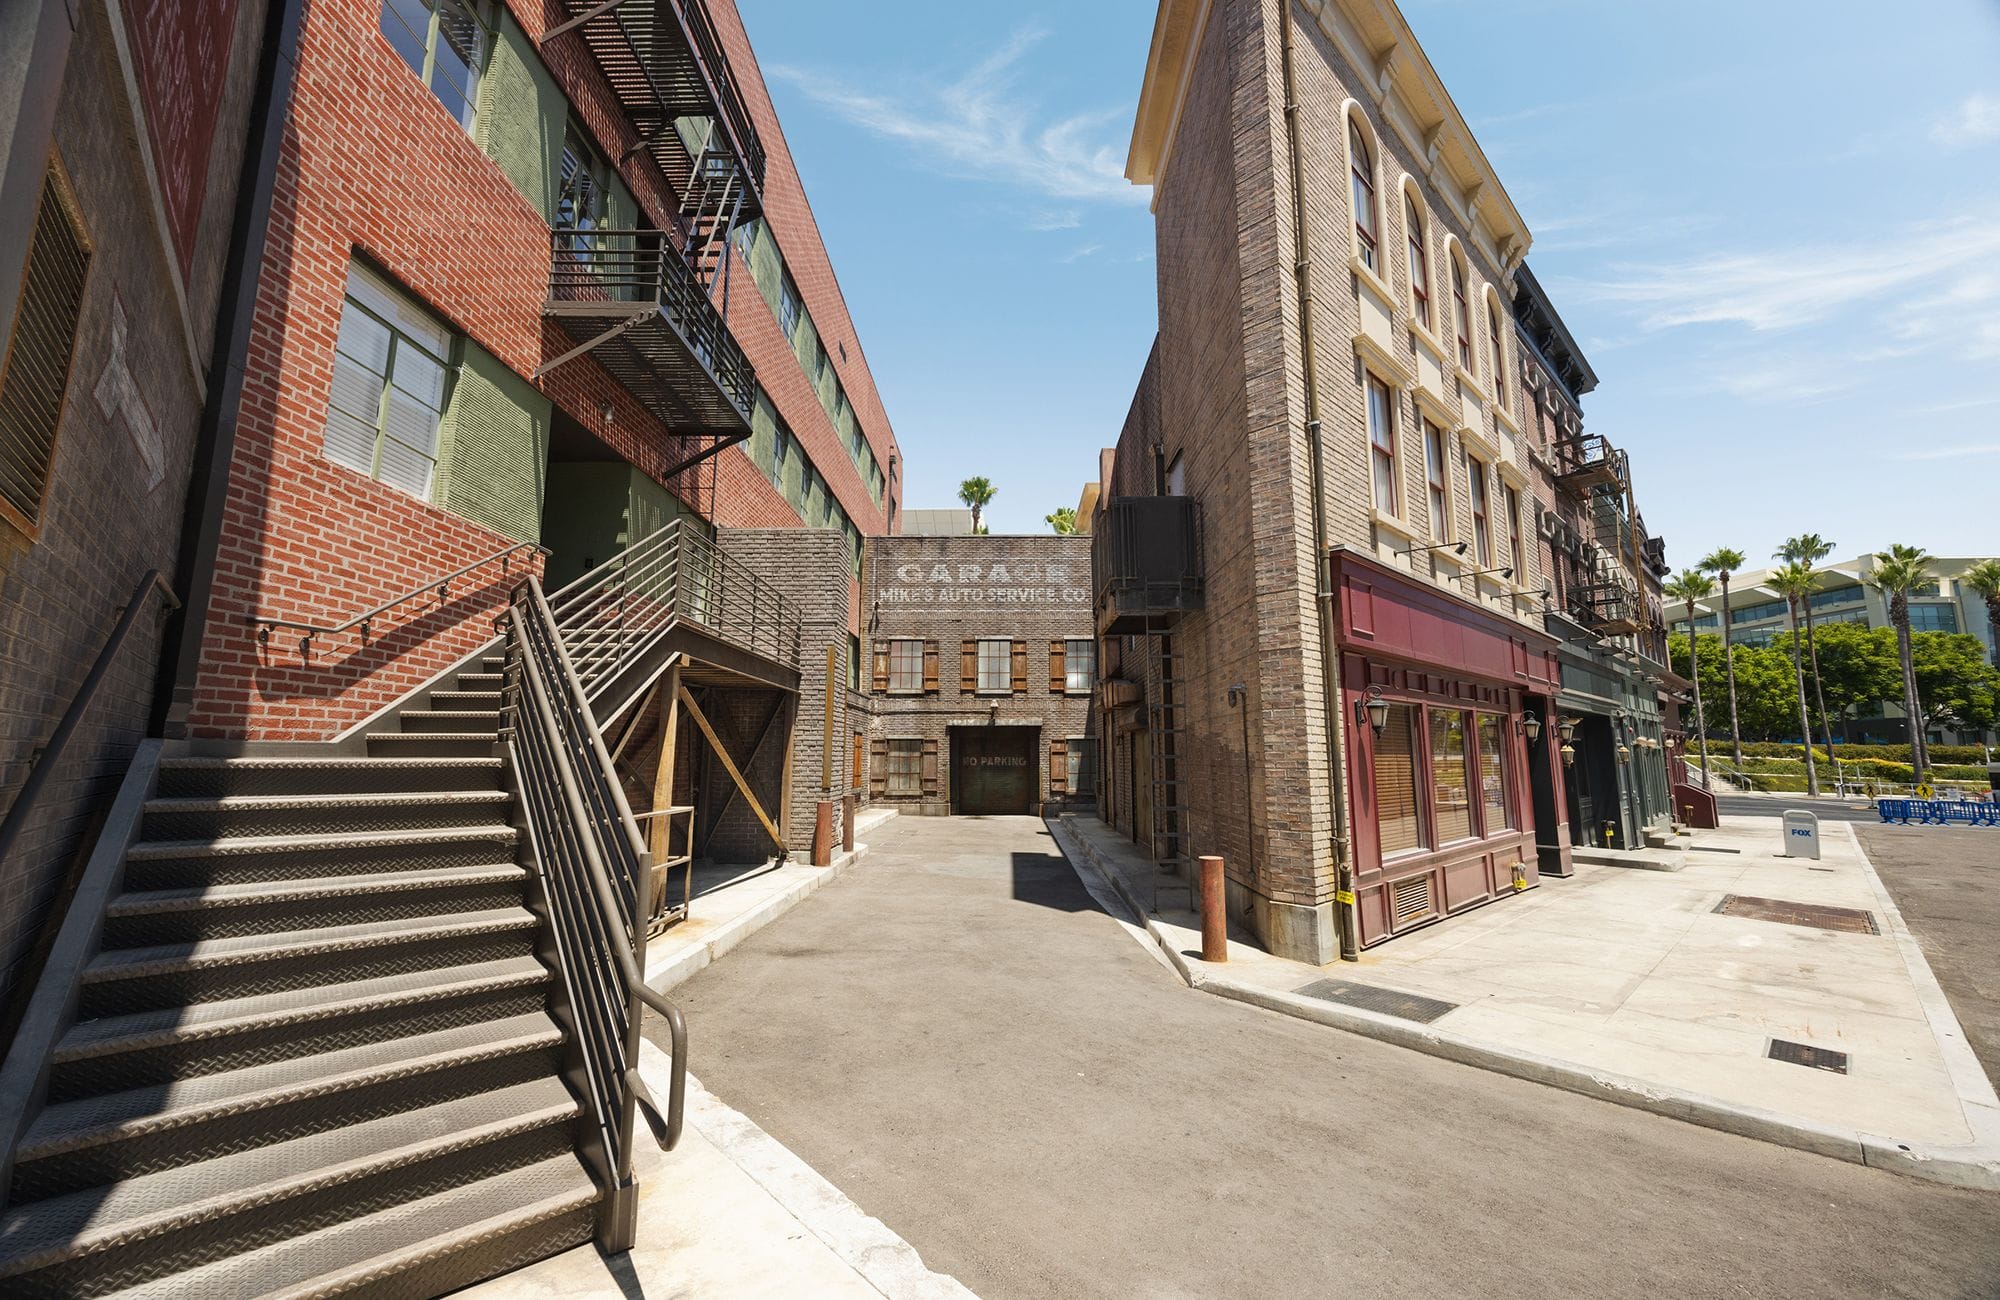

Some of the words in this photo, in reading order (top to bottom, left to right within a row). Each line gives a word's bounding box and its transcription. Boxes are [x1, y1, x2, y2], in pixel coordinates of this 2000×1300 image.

[897, 564, 1071, 584] GARAGE
[879, 588, 935, 602] MIKE'S
[938, 588, 984, 602] AUTO
[962, 756, 977, 766] NO
[980, 756, 1027, 766] PARKING
[1791, 828, 1812, 837] FOX
